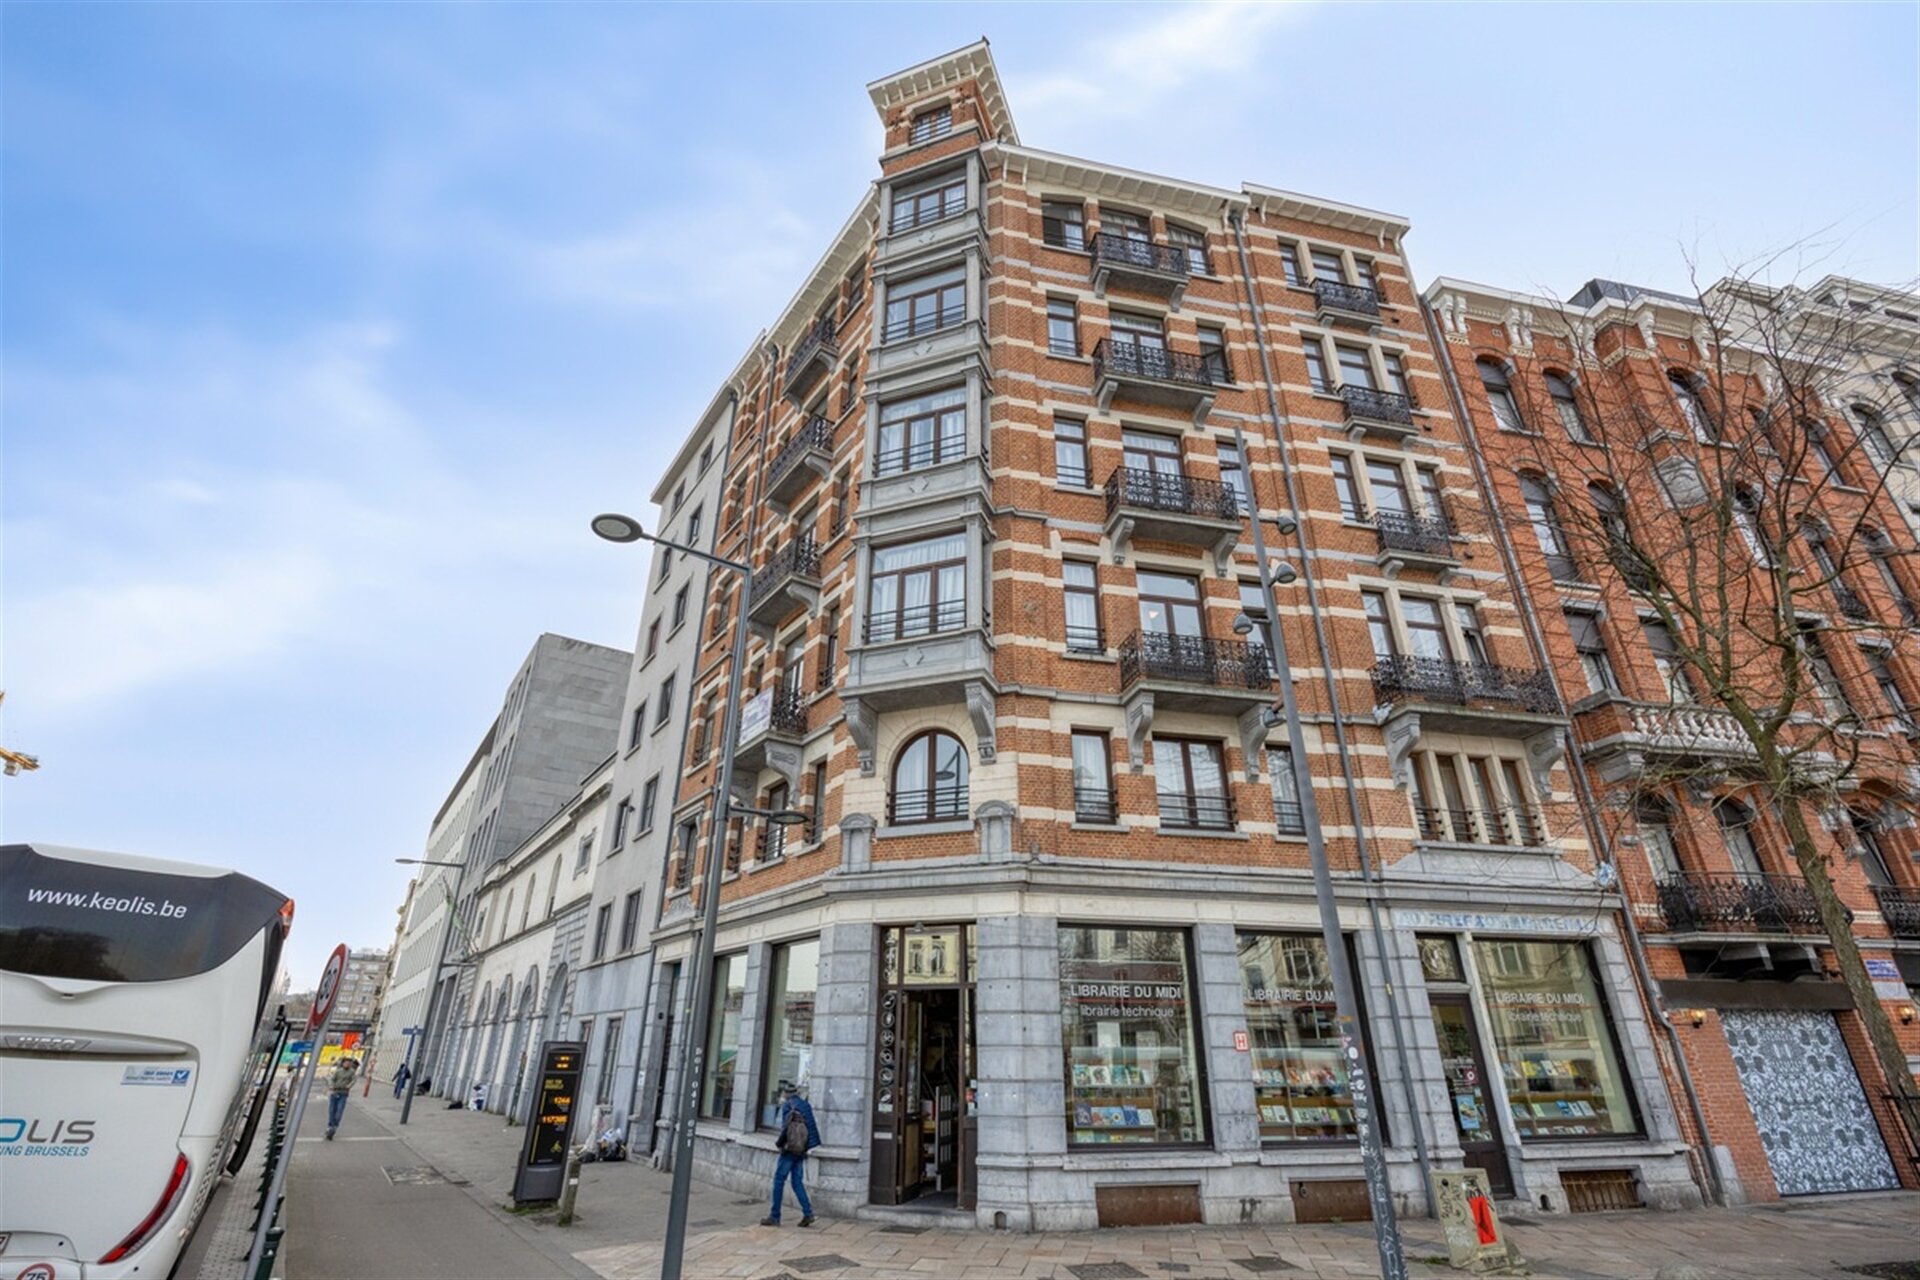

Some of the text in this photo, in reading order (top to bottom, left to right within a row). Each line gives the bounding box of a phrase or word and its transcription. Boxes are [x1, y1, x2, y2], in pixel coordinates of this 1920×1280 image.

[28, 888, 187, 918] www.keolis.be
[1070, 984, 1181, 999] LIBRAIRIE DU MIDI
[1247, 988, 1303, 1001] LIBRAIRIE
[1305, 990, 1322, 1001] DU
[1495, 990, 1585, 1004] LIBRAIRIE DU MIDI
[1081, 1004, 1174, 1018] librairie technique
[24, 1146, 90, 1157] BRUSSELS
